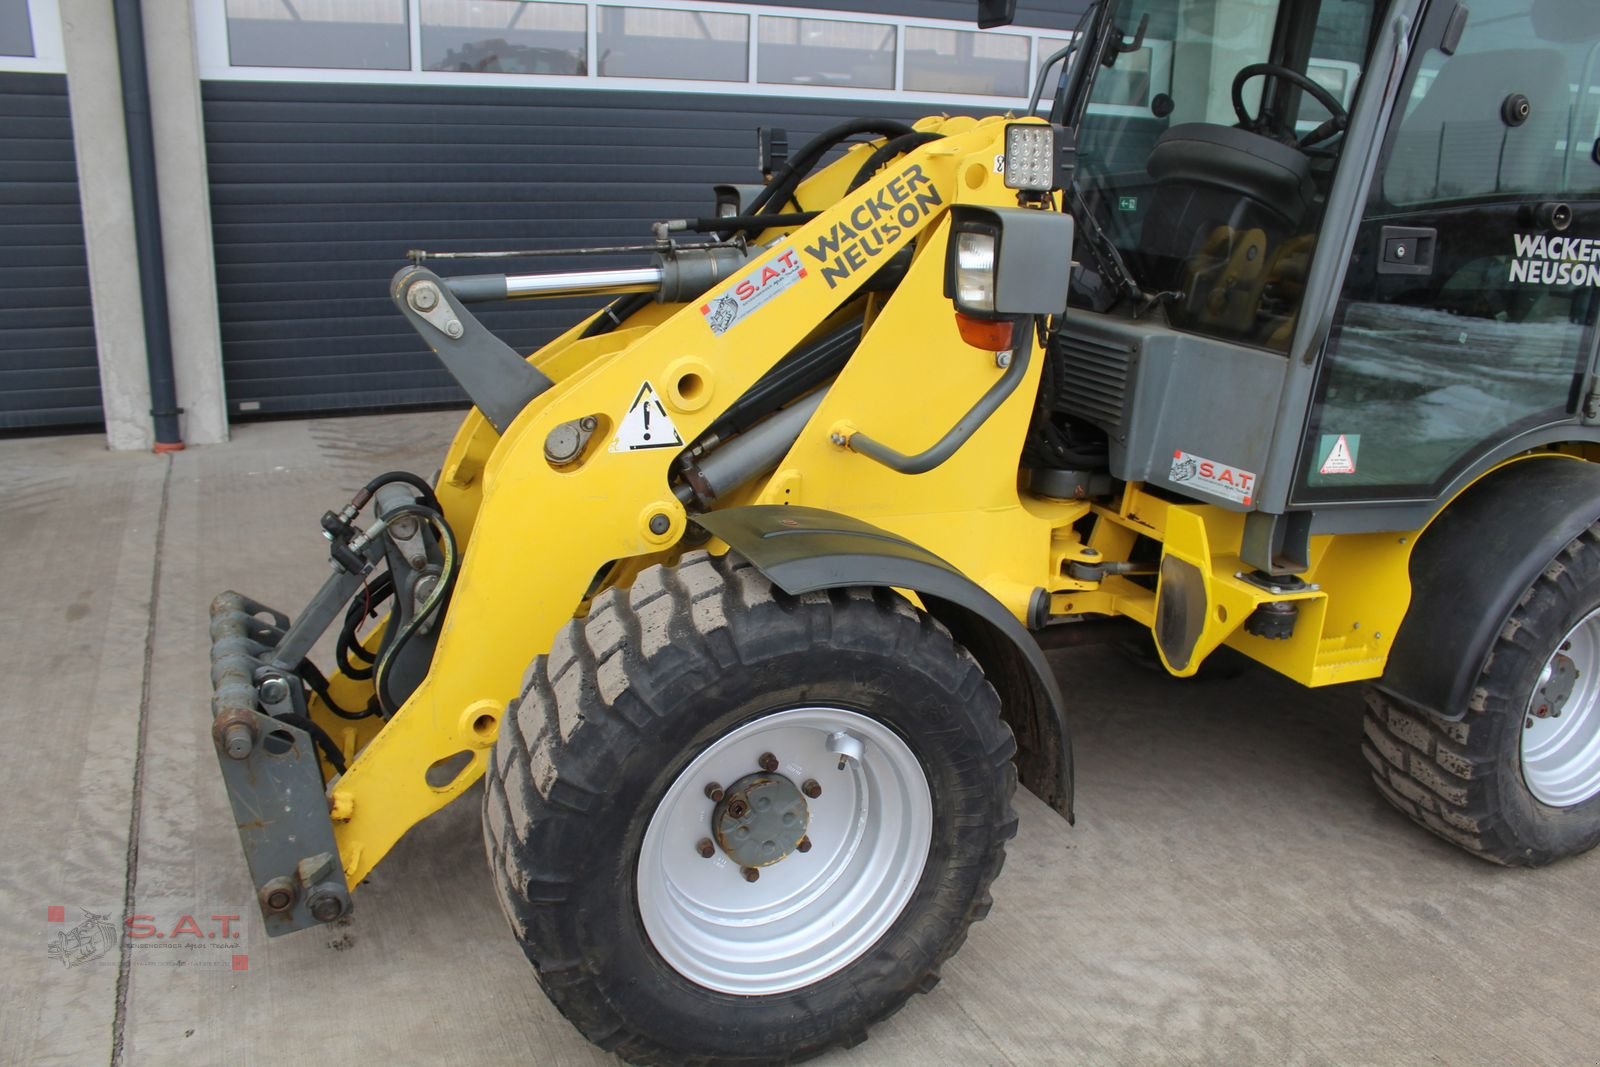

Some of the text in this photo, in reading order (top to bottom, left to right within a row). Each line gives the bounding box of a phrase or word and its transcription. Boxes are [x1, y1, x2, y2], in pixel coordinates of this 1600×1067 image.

[803, 163, 931, 263] WACKER
[820, 183, 943, 290] NEUSON
[735, 249, 799, 301] S.A.T.
[1508, 259, 1600, 287] NEUSON
[1199, 462, 1253, 491] S.A.T.
